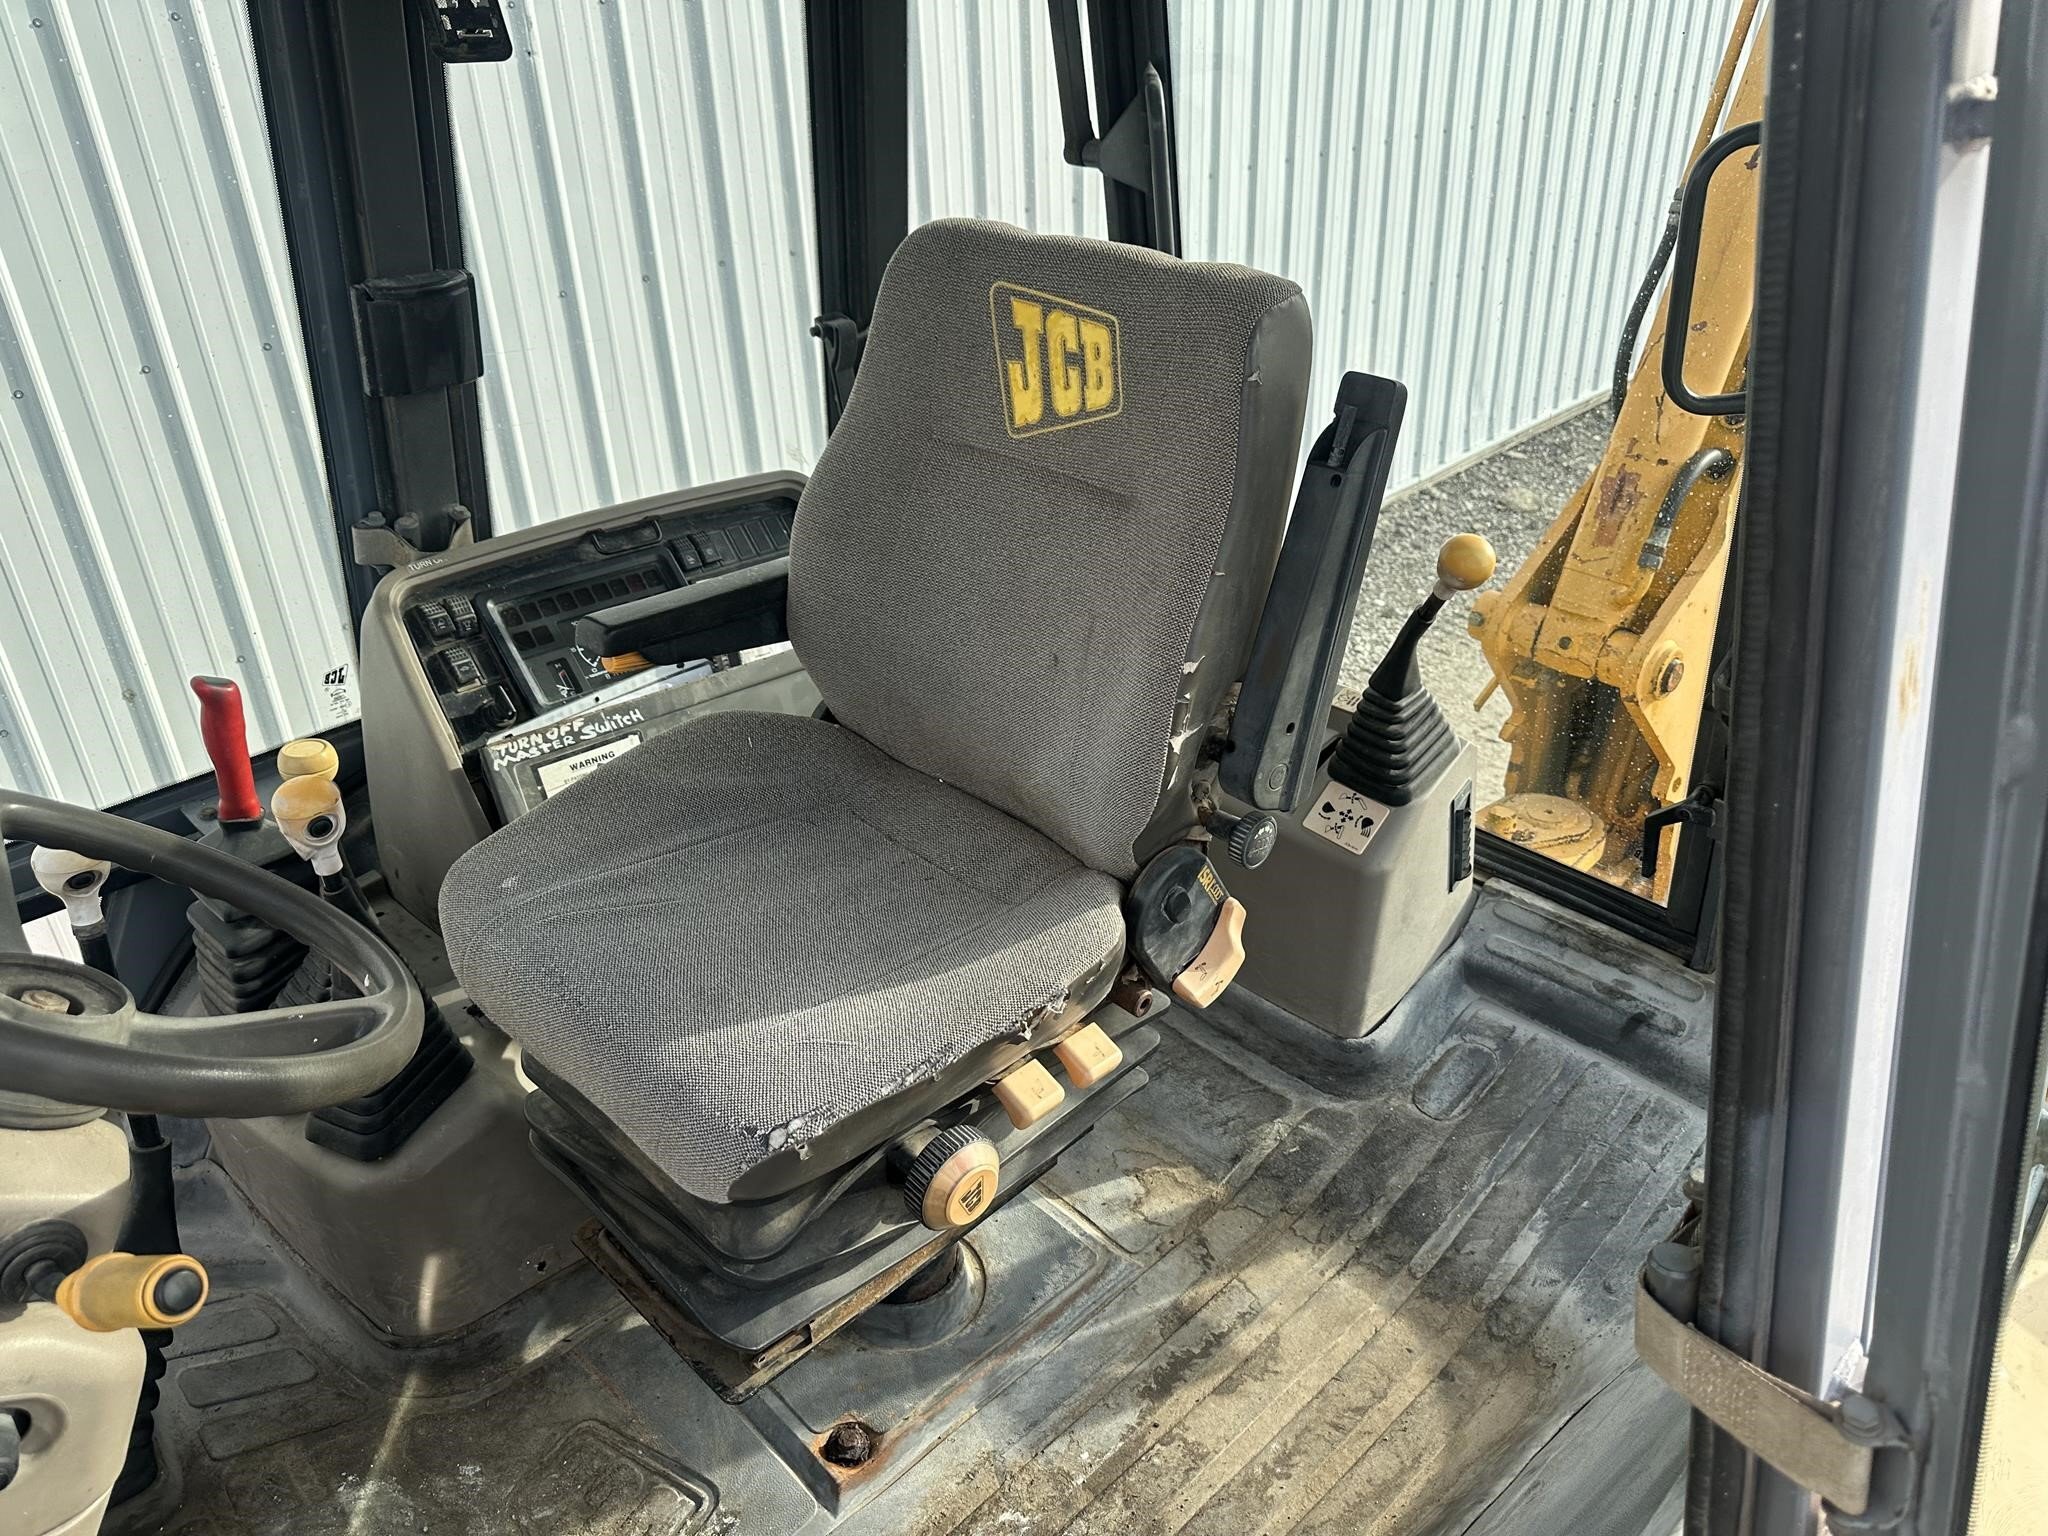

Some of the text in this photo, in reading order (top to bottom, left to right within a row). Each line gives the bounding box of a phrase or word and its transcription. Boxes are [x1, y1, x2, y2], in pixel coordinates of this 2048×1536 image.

[1006, 298, 1113, 427] JCB
[493, 736, 577, 771] MASTER
[496, 718, 585, 757] TURN OFF
[569, 750, 616, 772] WARNING
[961, 1181, 982, 1212] JCB
